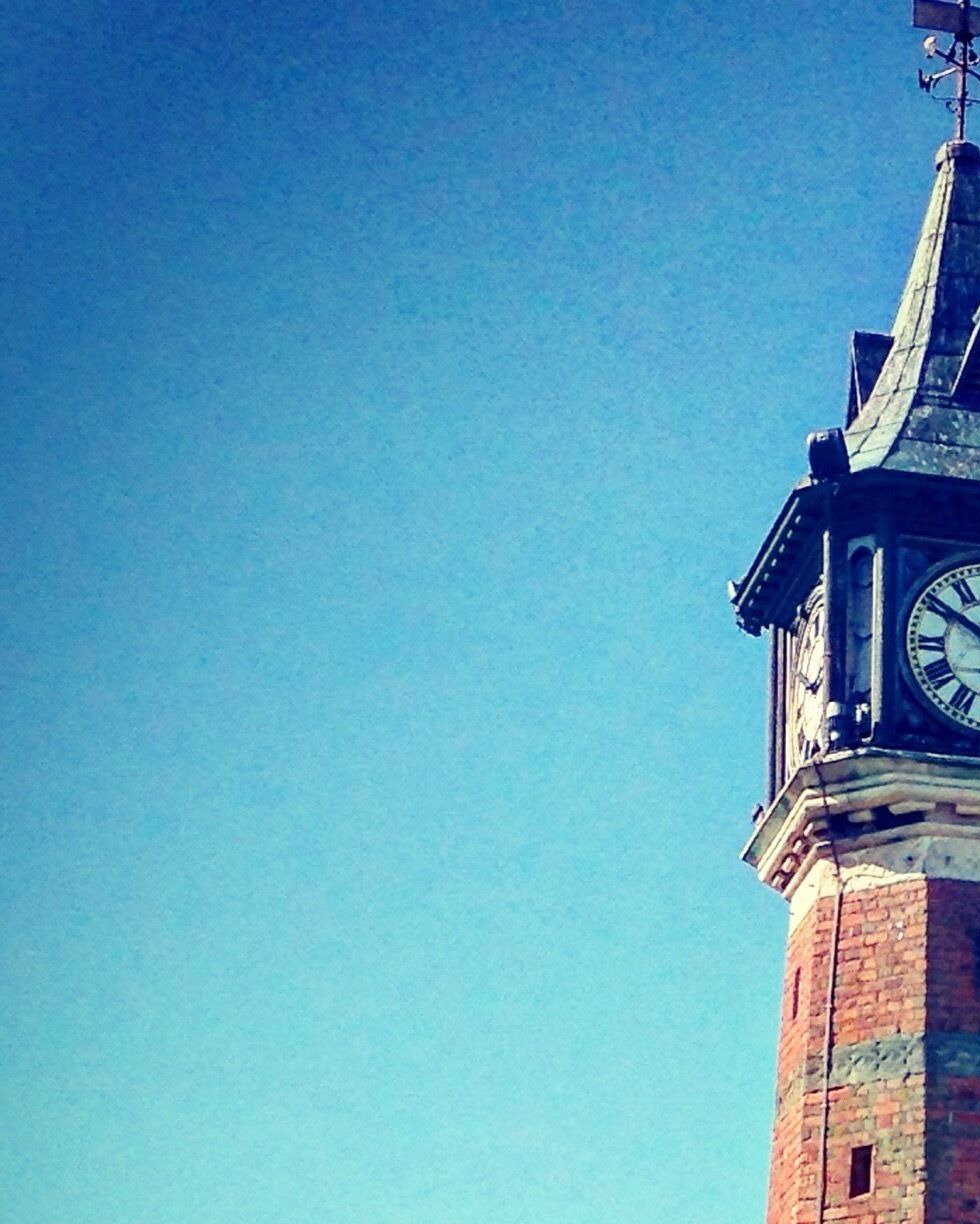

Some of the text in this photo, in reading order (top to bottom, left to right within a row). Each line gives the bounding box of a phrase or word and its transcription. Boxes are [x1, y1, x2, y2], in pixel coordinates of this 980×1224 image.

[950, 578, 977, 607] XI
[917, 633, 945, 652] IX
[948, 683, 976, 715] VII
